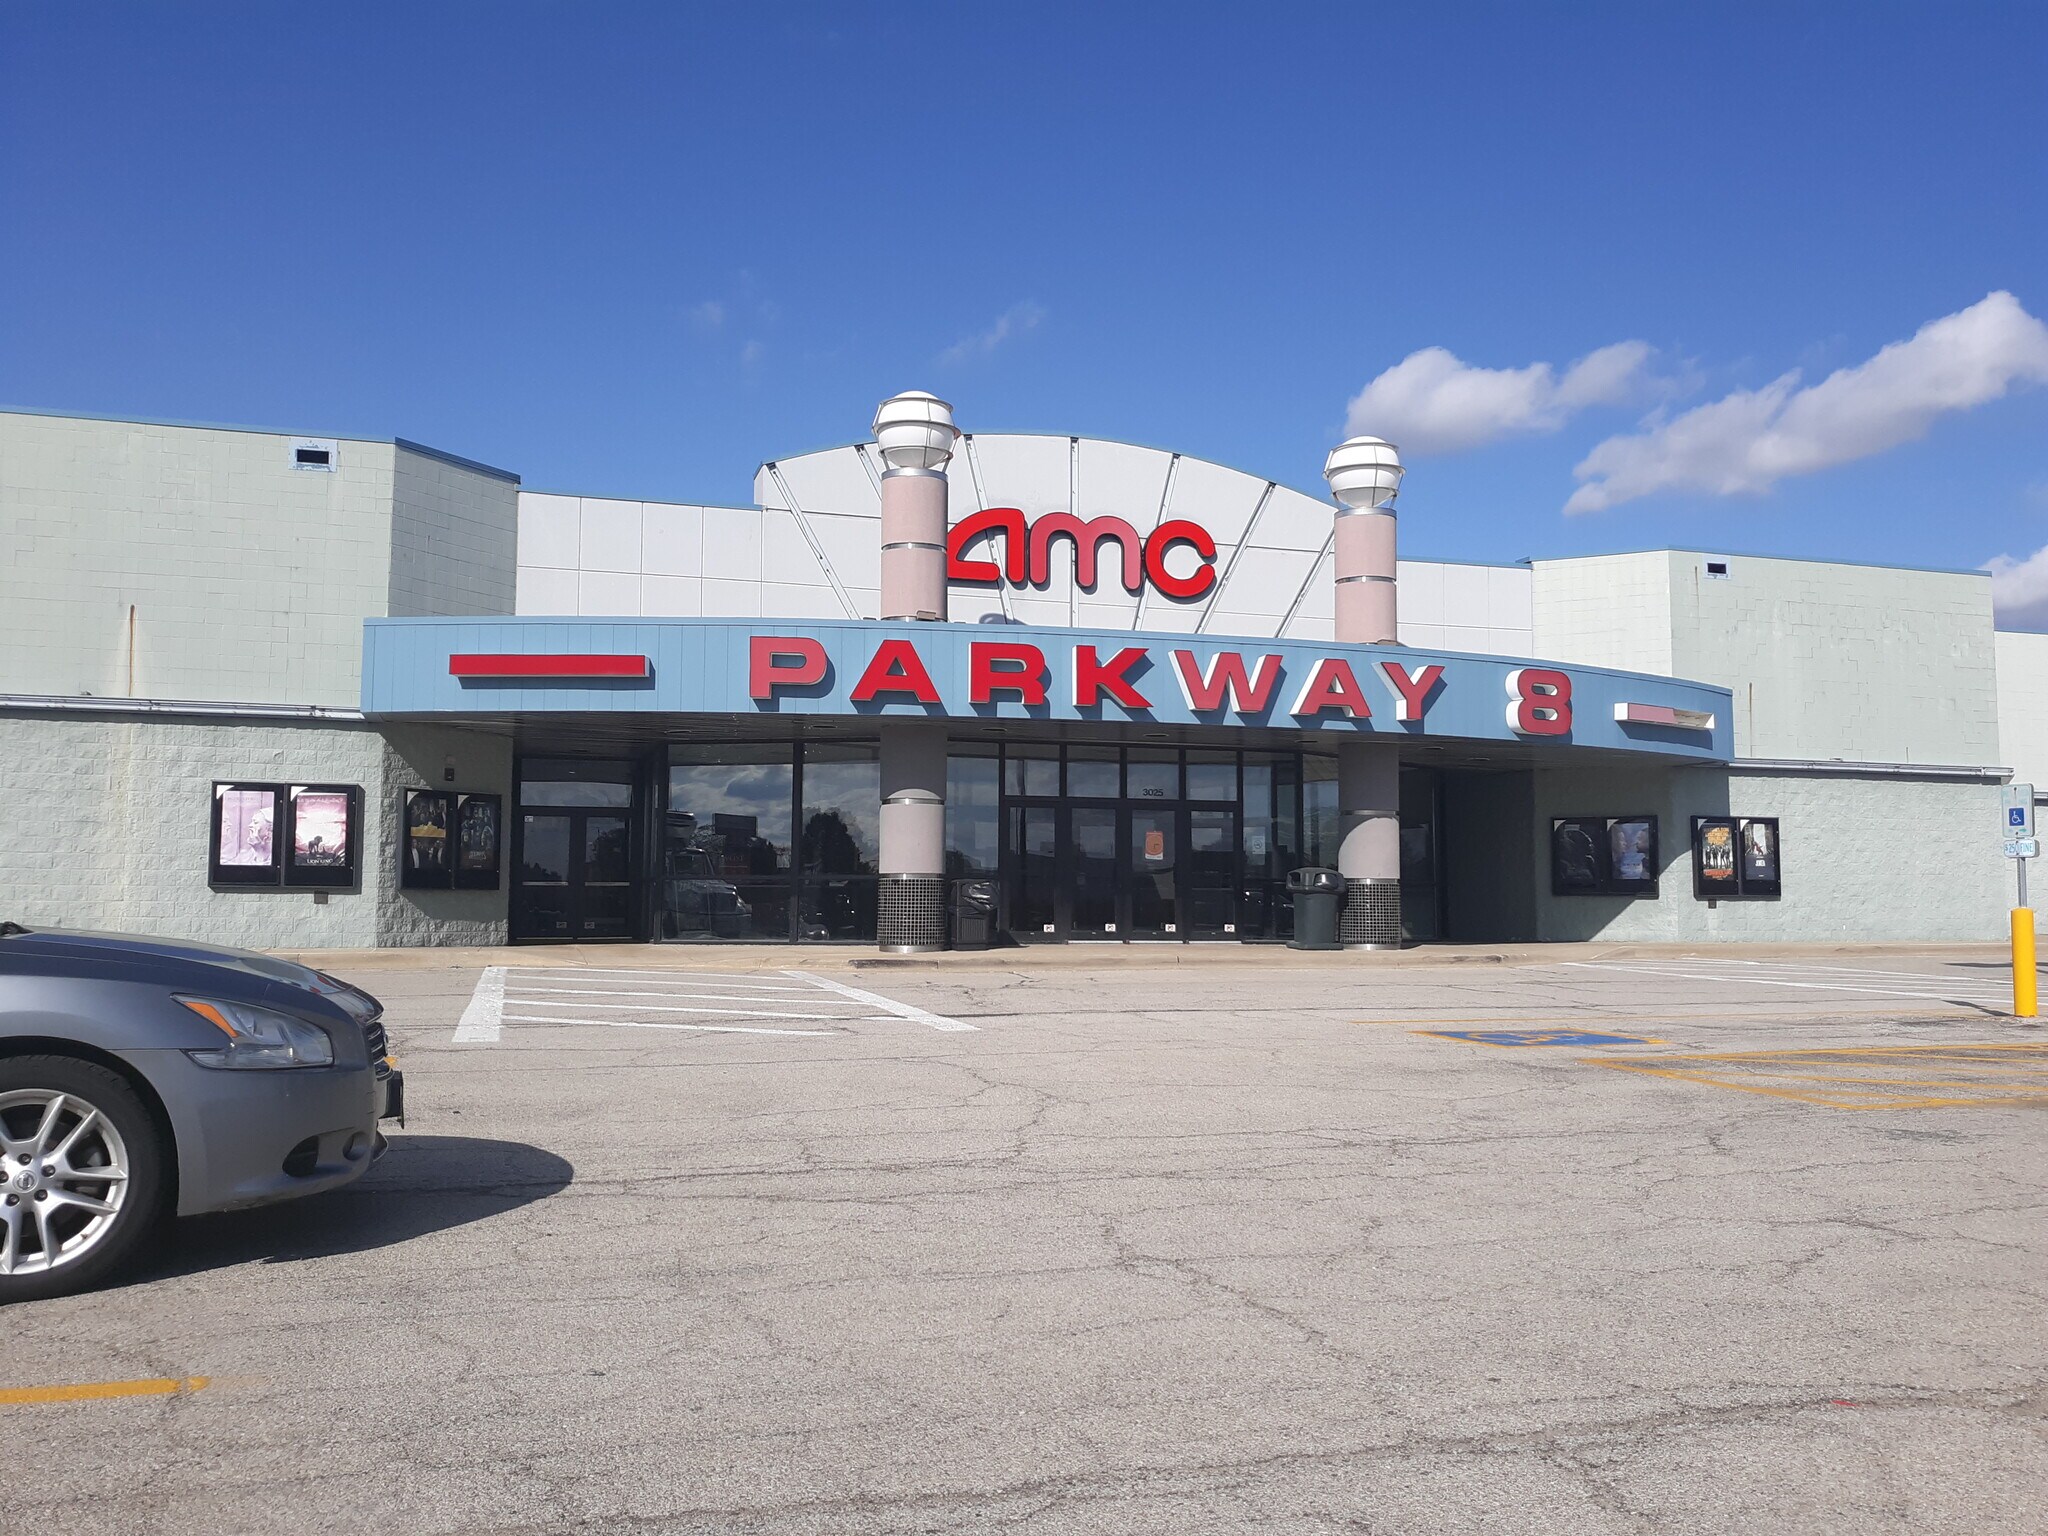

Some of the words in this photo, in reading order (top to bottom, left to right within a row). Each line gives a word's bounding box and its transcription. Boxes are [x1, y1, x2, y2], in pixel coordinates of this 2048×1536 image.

[749, 635, 1446, 721] PARKWAY
[1504, 668, 1573, 736] 8
[1142, 788, 1164, 797] 3025
